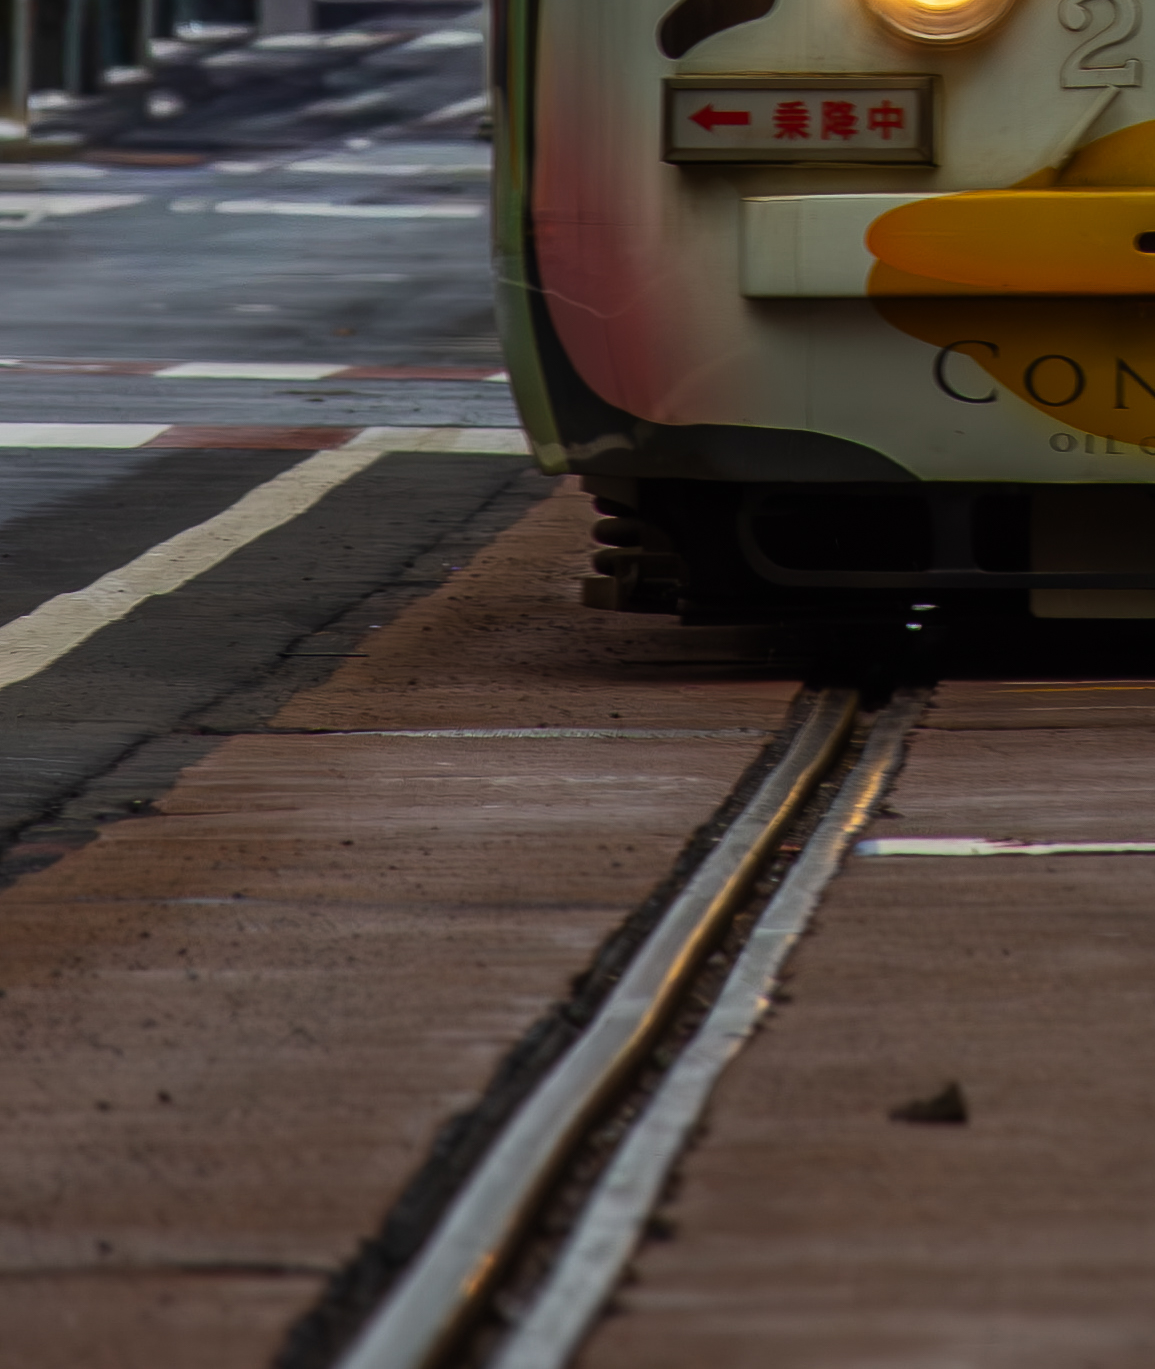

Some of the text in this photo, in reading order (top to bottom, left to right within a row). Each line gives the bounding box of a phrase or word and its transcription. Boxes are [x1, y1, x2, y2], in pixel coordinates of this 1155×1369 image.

[772, 99, 906, 141] 乗降中
[1049, 432, 1126, 455] OIL
